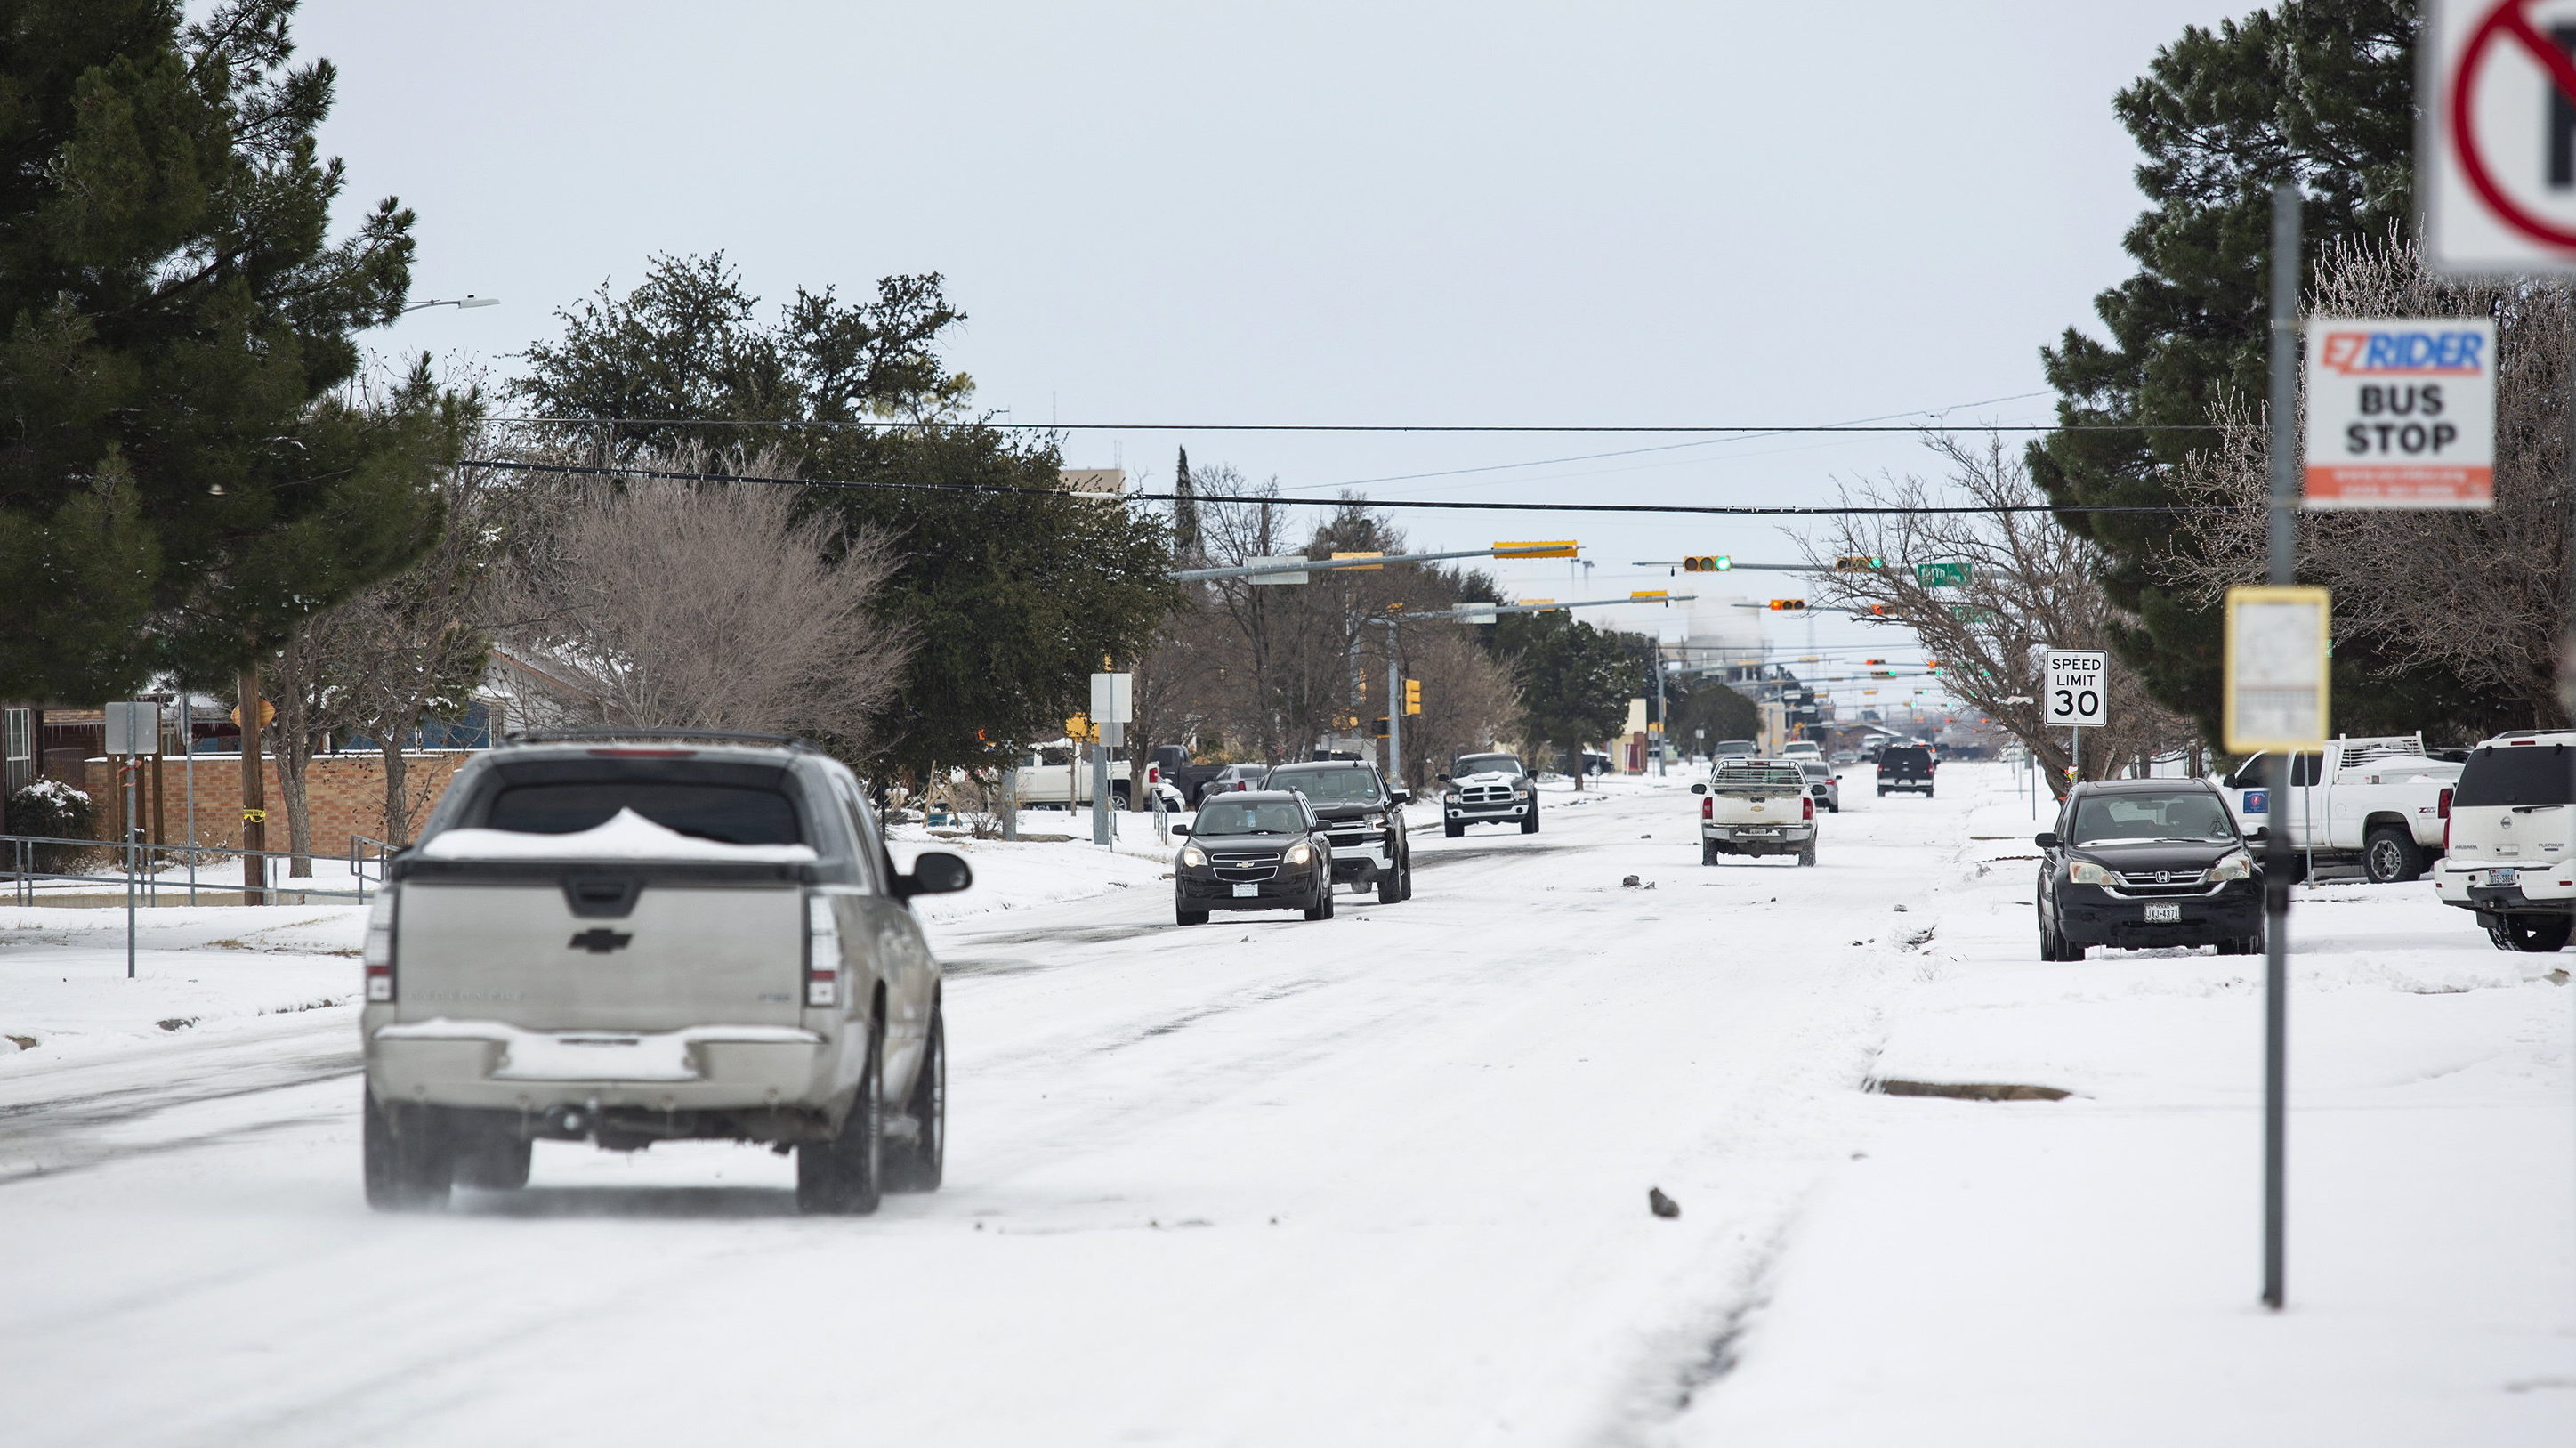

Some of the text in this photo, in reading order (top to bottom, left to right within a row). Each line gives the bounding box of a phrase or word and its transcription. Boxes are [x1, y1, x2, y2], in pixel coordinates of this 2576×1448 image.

[2360, 384, 2444, 417] BUS
[2346, 422, 2458, 455] STOP
[2052, 659, 2101, 671] SPEED
[2056, 675, 2096, 686] LIMIT
[2054, 689, 2099, 716] 30
